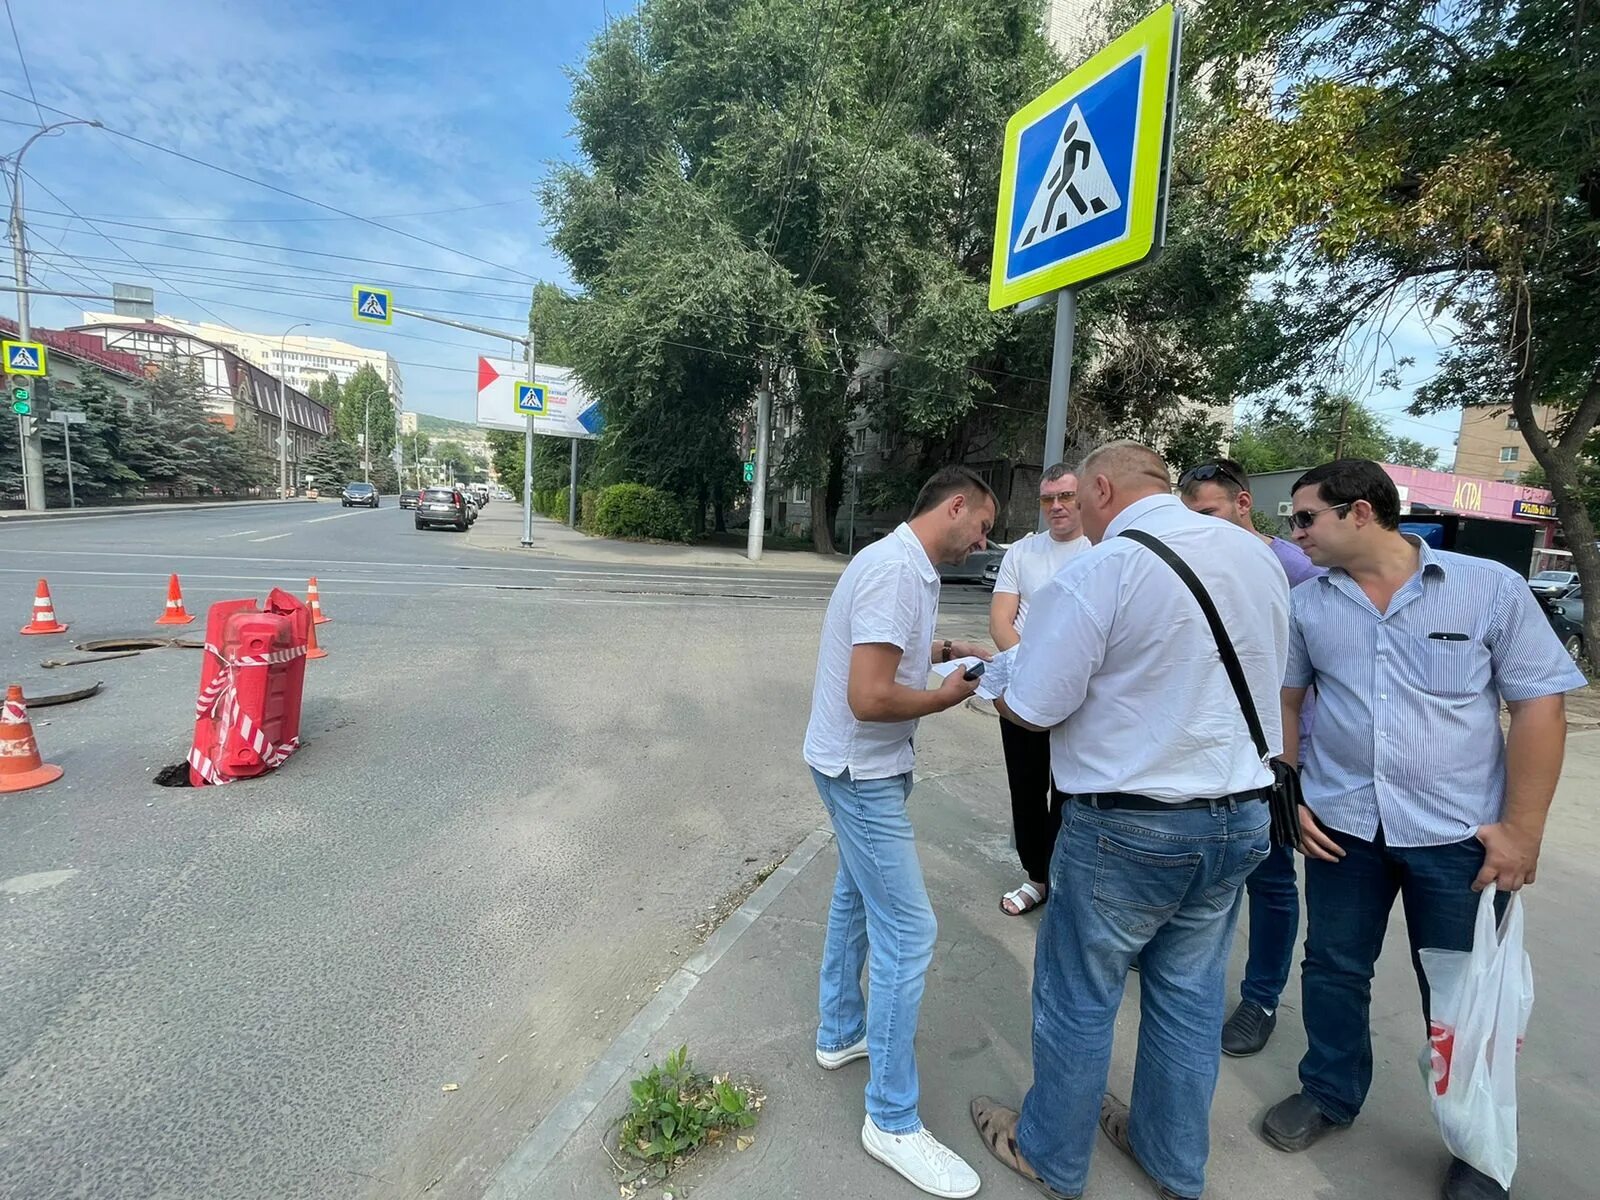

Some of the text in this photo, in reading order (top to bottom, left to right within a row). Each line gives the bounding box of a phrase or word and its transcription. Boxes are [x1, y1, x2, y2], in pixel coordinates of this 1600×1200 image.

[16, 390, 28, 399] 23
[1453, 480, 1482, 511] АСТРА
[1520, 503, 1539, 514] РУБЛЬ
